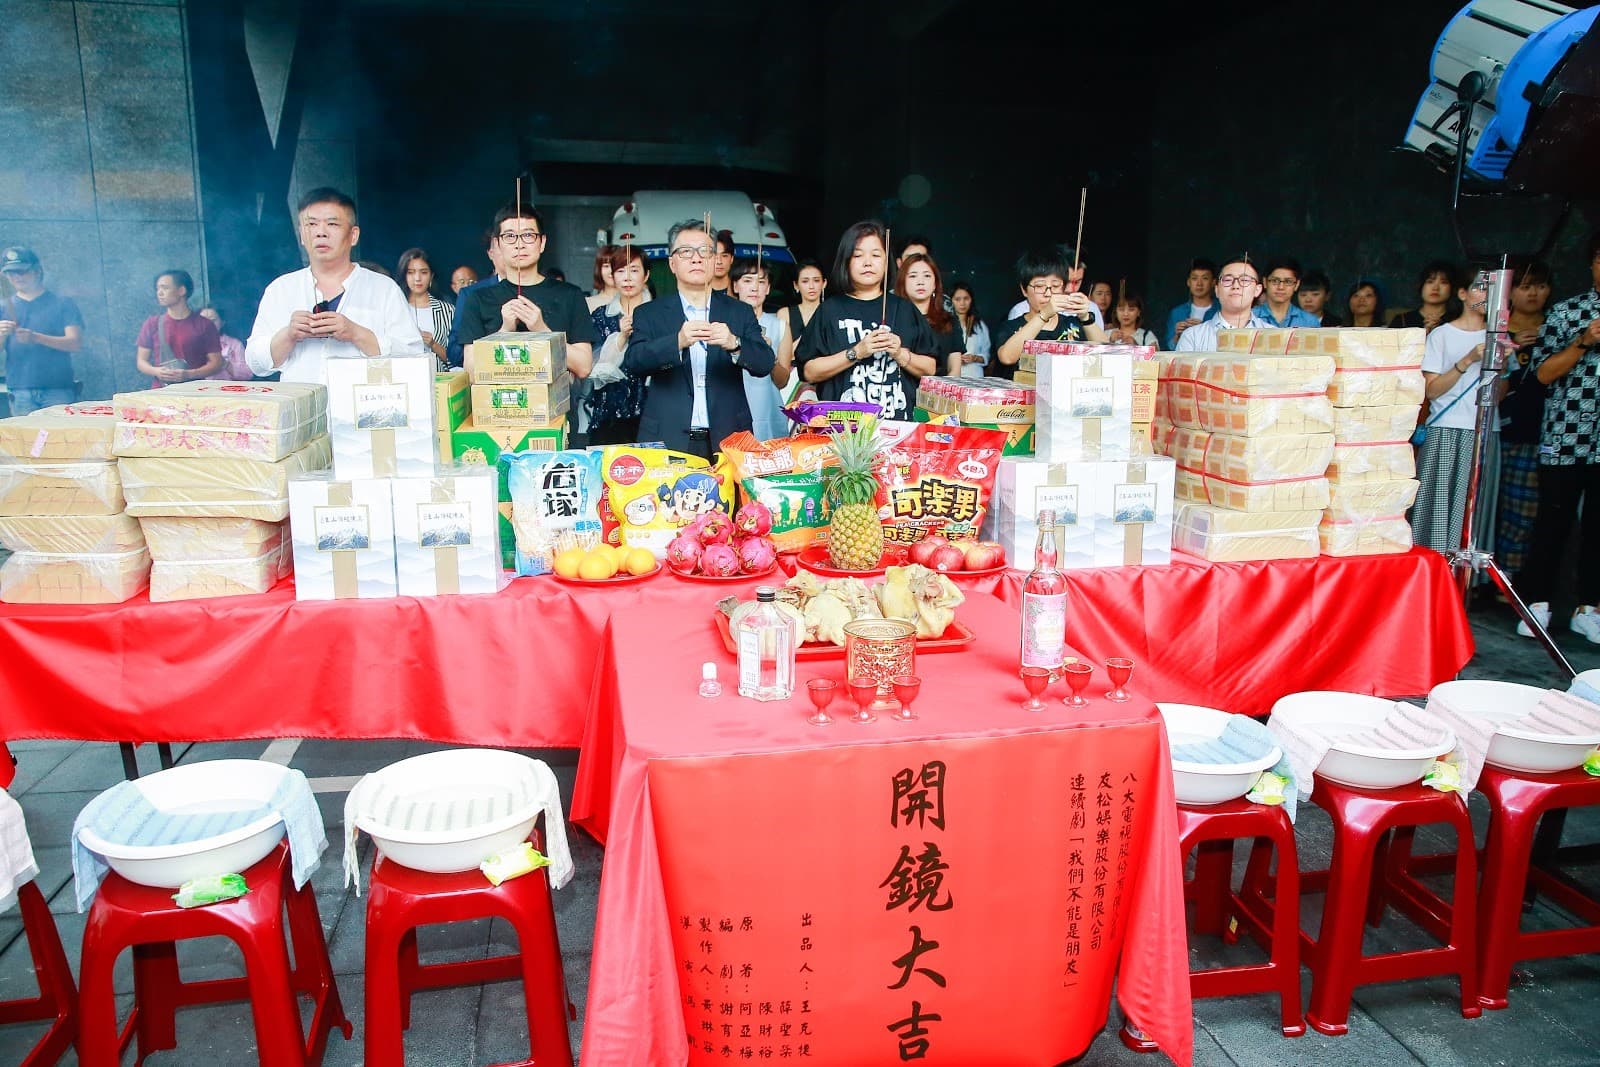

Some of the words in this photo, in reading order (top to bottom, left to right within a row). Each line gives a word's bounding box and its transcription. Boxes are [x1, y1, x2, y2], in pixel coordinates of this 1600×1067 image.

[743, 446, 796, 475] 卡迪那
[878, 759, 954, 1063] 開鏡大吉
